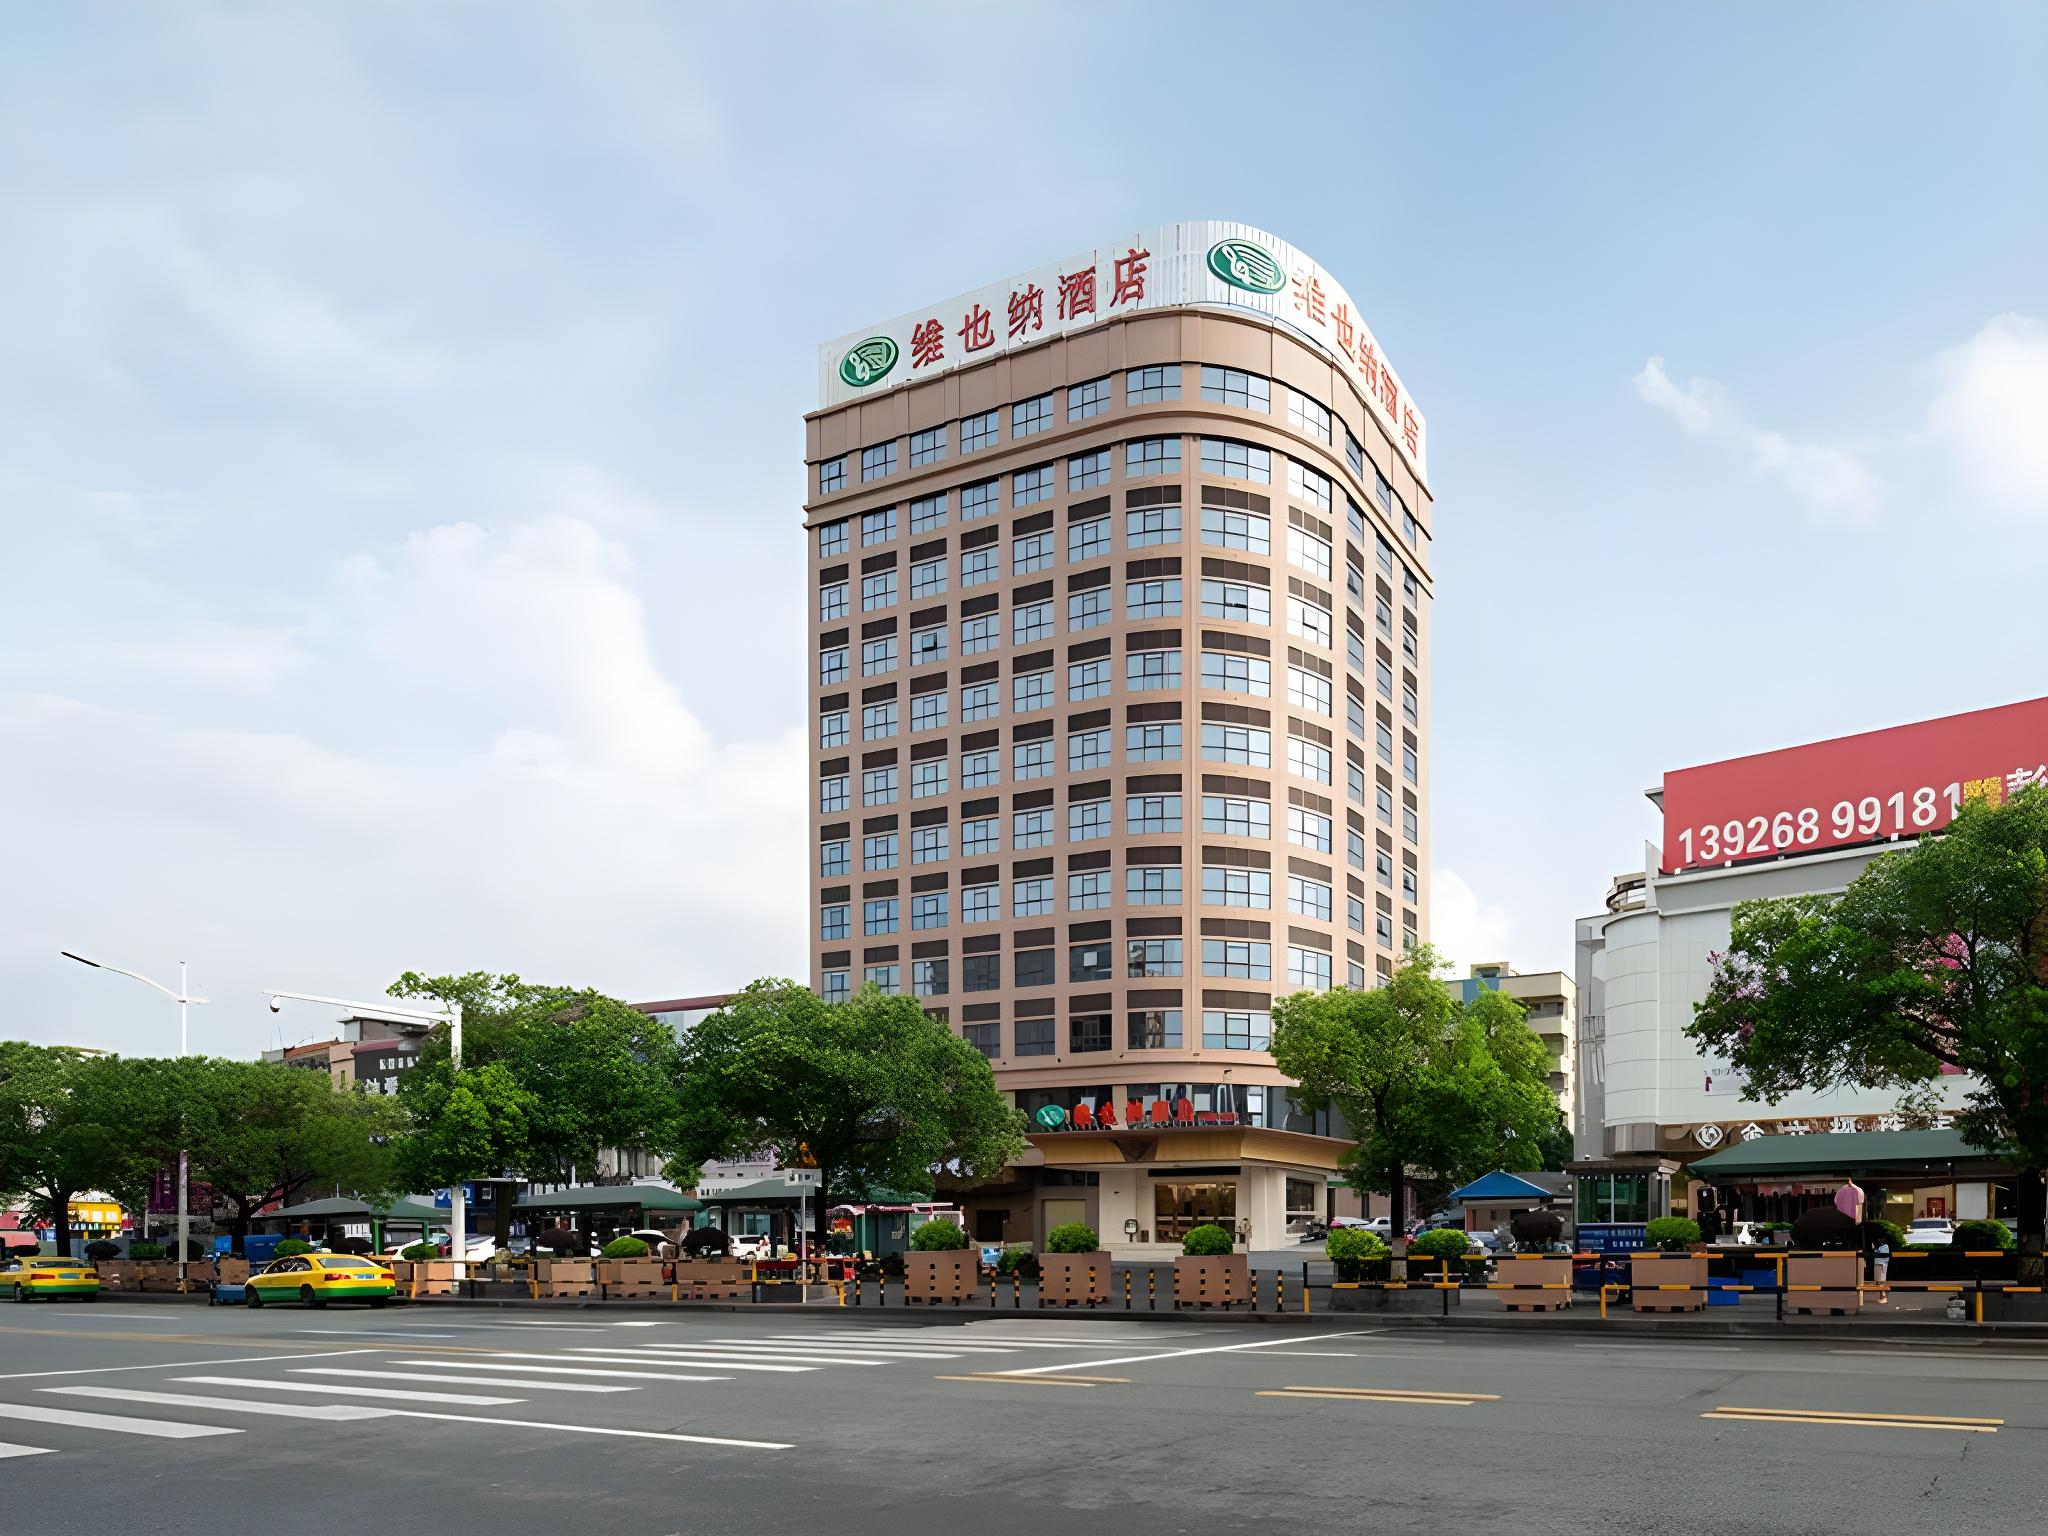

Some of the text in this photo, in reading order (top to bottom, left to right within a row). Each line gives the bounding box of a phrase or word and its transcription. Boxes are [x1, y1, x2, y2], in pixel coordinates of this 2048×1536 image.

[911, 248, 1150, 368] 维也纳酒店
[1678, 807, 1820, 864] 139268
[1831, 782, 1960, 839] 99181
